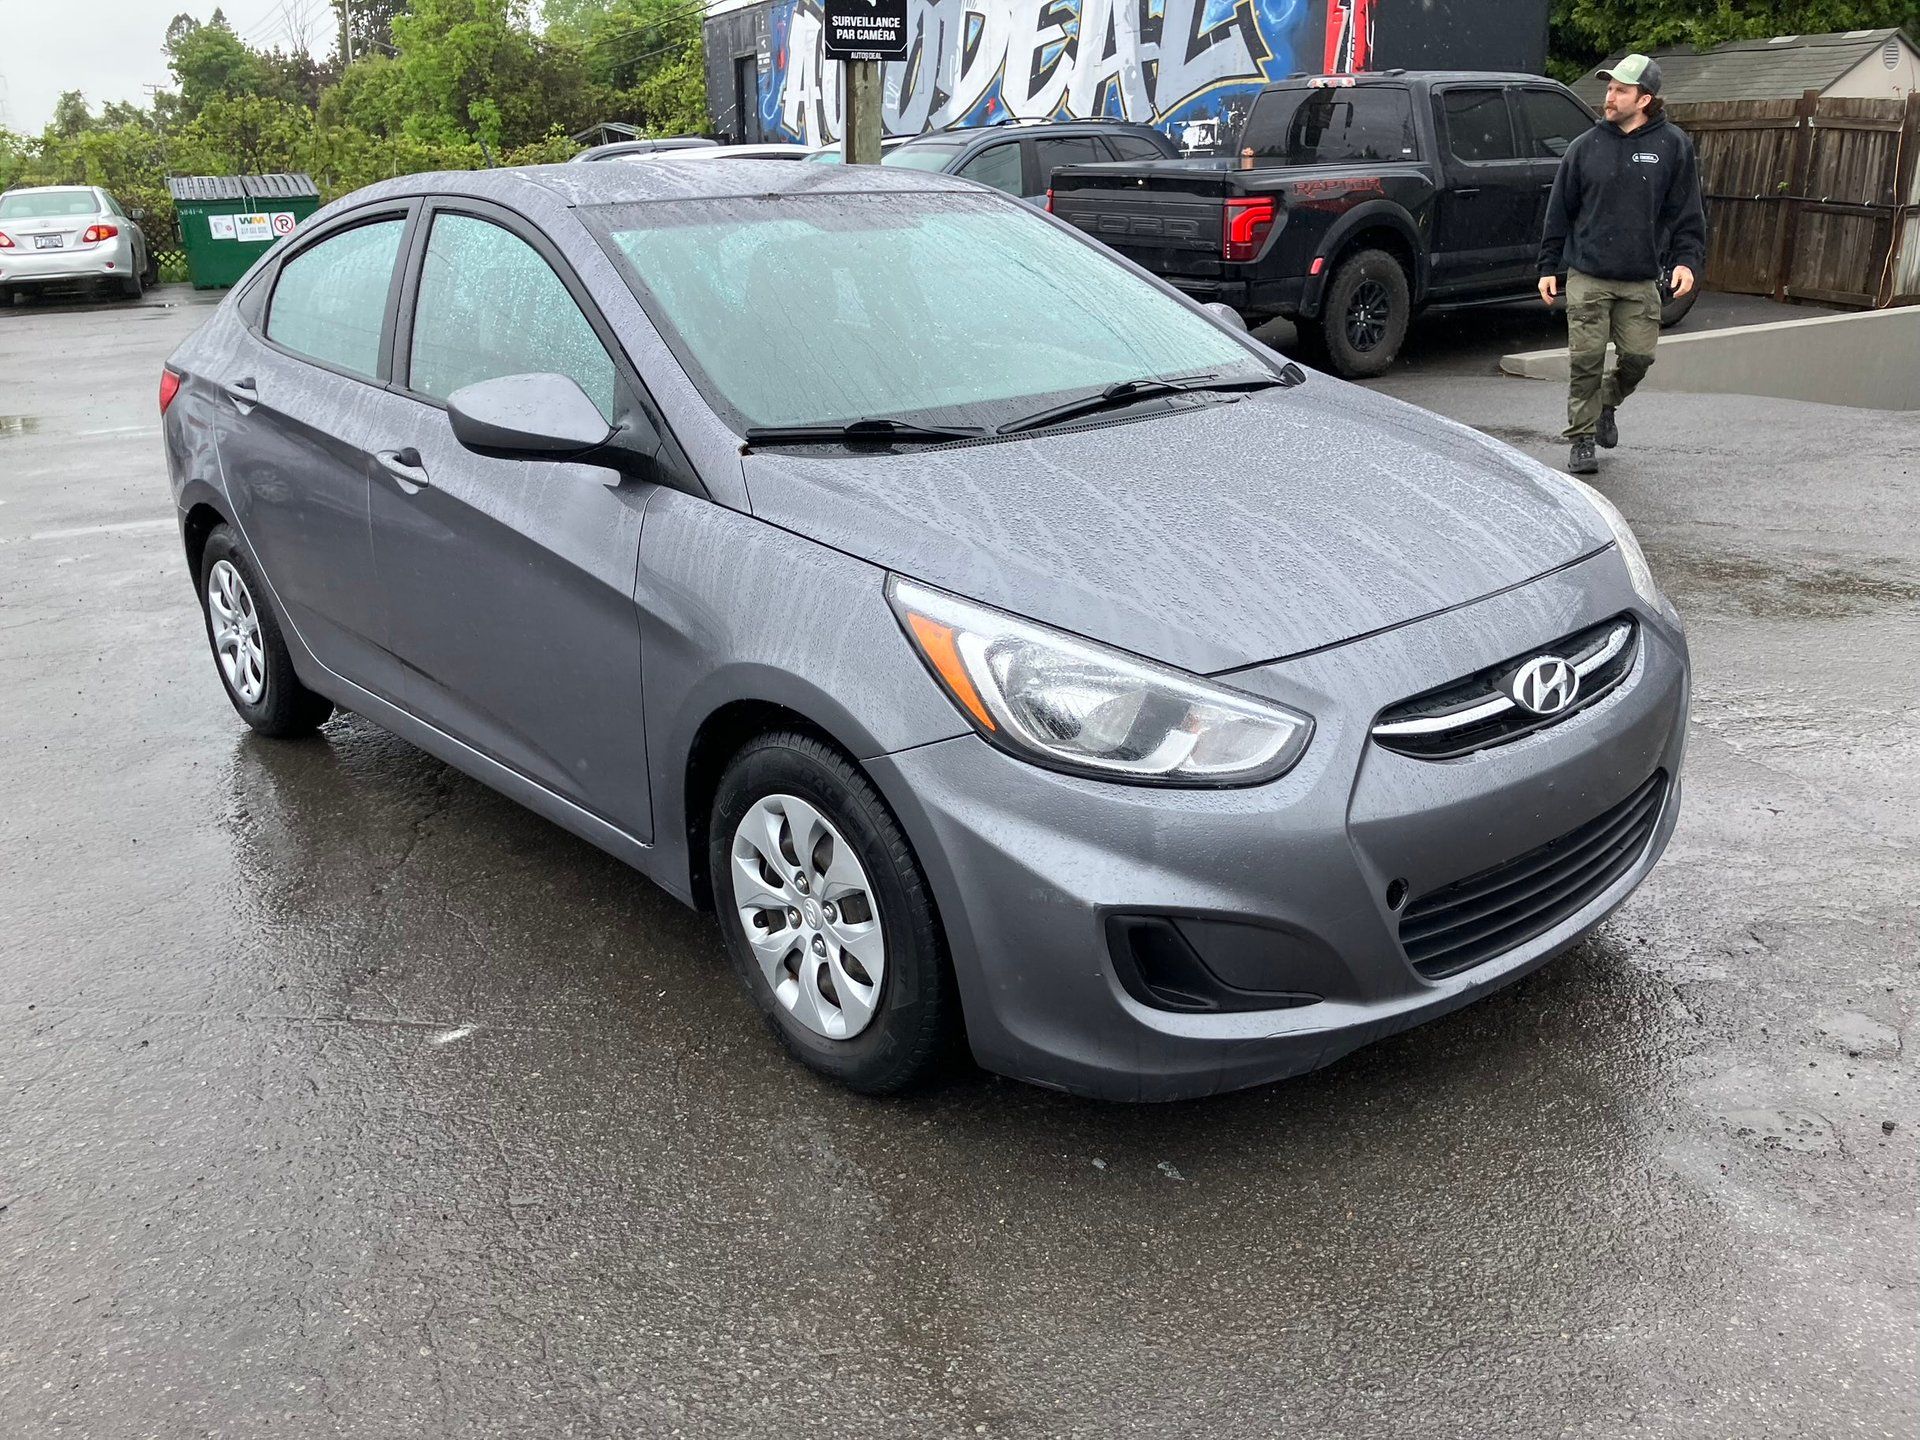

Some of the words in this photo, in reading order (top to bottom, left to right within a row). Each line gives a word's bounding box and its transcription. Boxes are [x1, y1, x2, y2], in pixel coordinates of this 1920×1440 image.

[831, 15, 901, 28] SURVEILLANCE
[836, 28, 855, 40] PAR
[856, 28, 896, 41] CAMÉRA
[1292, 176, 1385, 199] RAPTOR
[238, 216, 266, 225] WM
[1070, 213, 1200, 236] FORD
